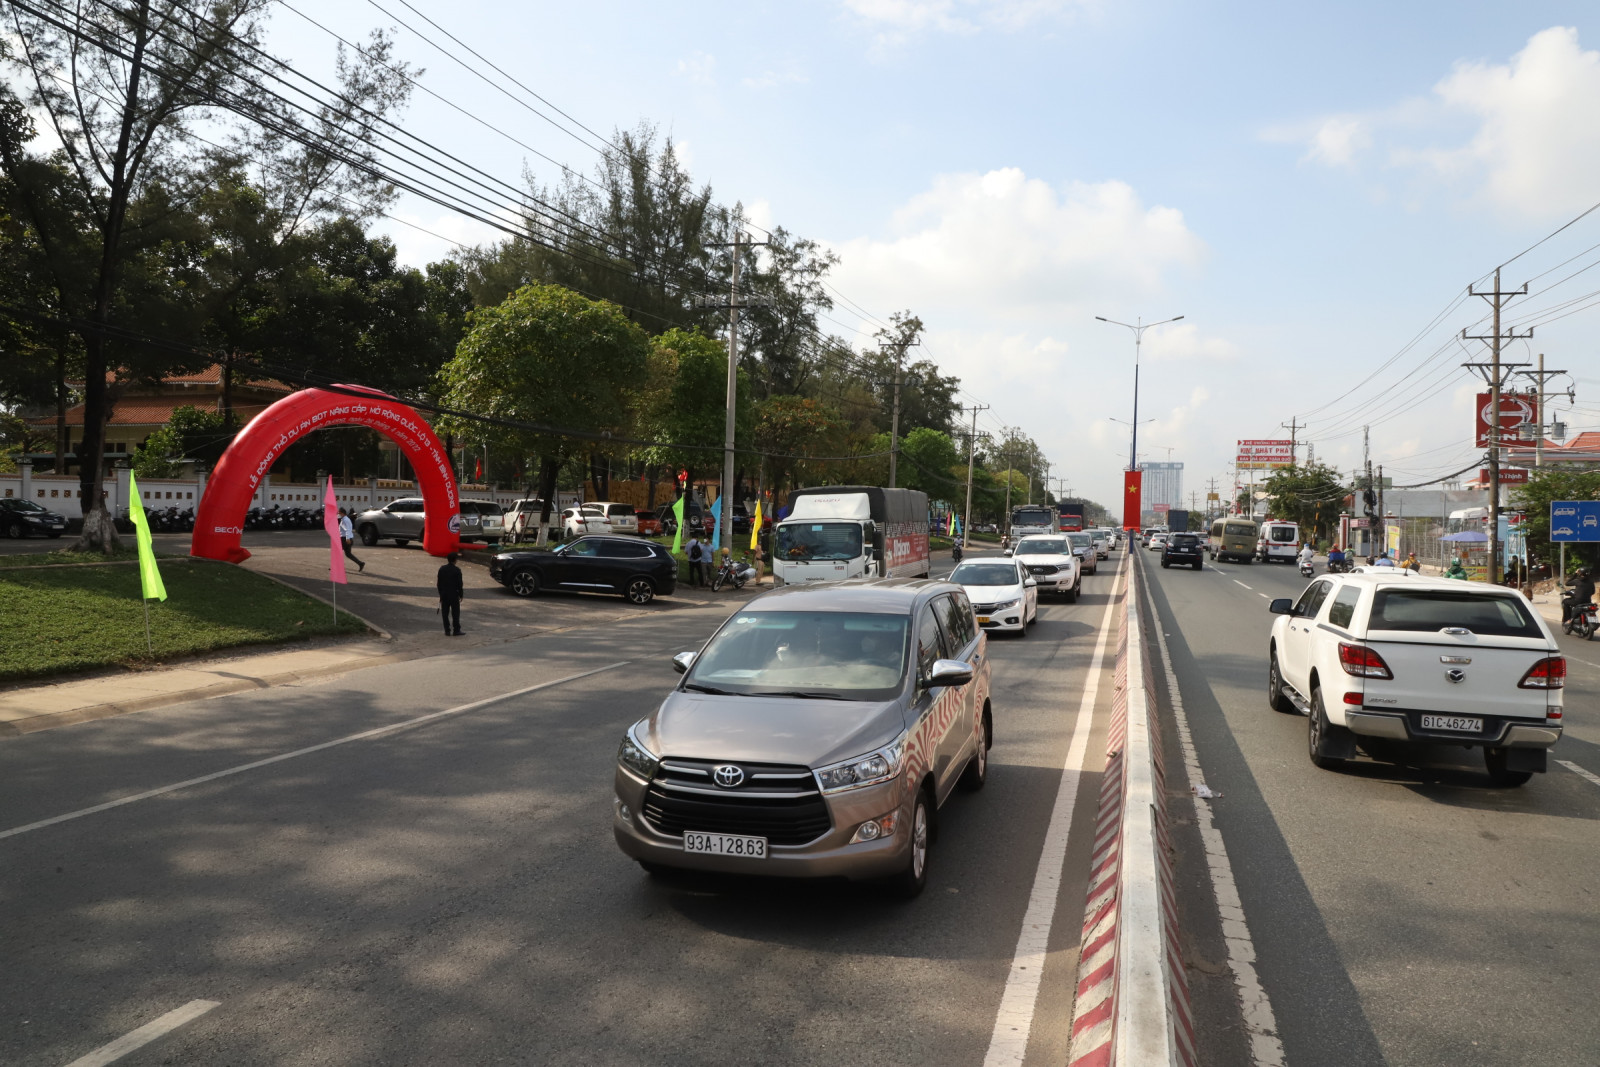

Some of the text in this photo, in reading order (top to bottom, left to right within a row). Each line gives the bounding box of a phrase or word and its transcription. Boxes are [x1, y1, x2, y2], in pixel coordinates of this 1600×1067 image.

[257, 451, 274, 475] ĐỘNG
[273, 434, 288, 452] THỔ
[311, 410, 328, 422] BOT
[329, 406, 350, 416] NÂNG
[381, 409, 401, 422] RỘNG
[400, 418, 418, 434] QUỐC
[1423, 716, 1481, 730] 61C-462.74
[687, 834, 764, 856] 93A-128.63
